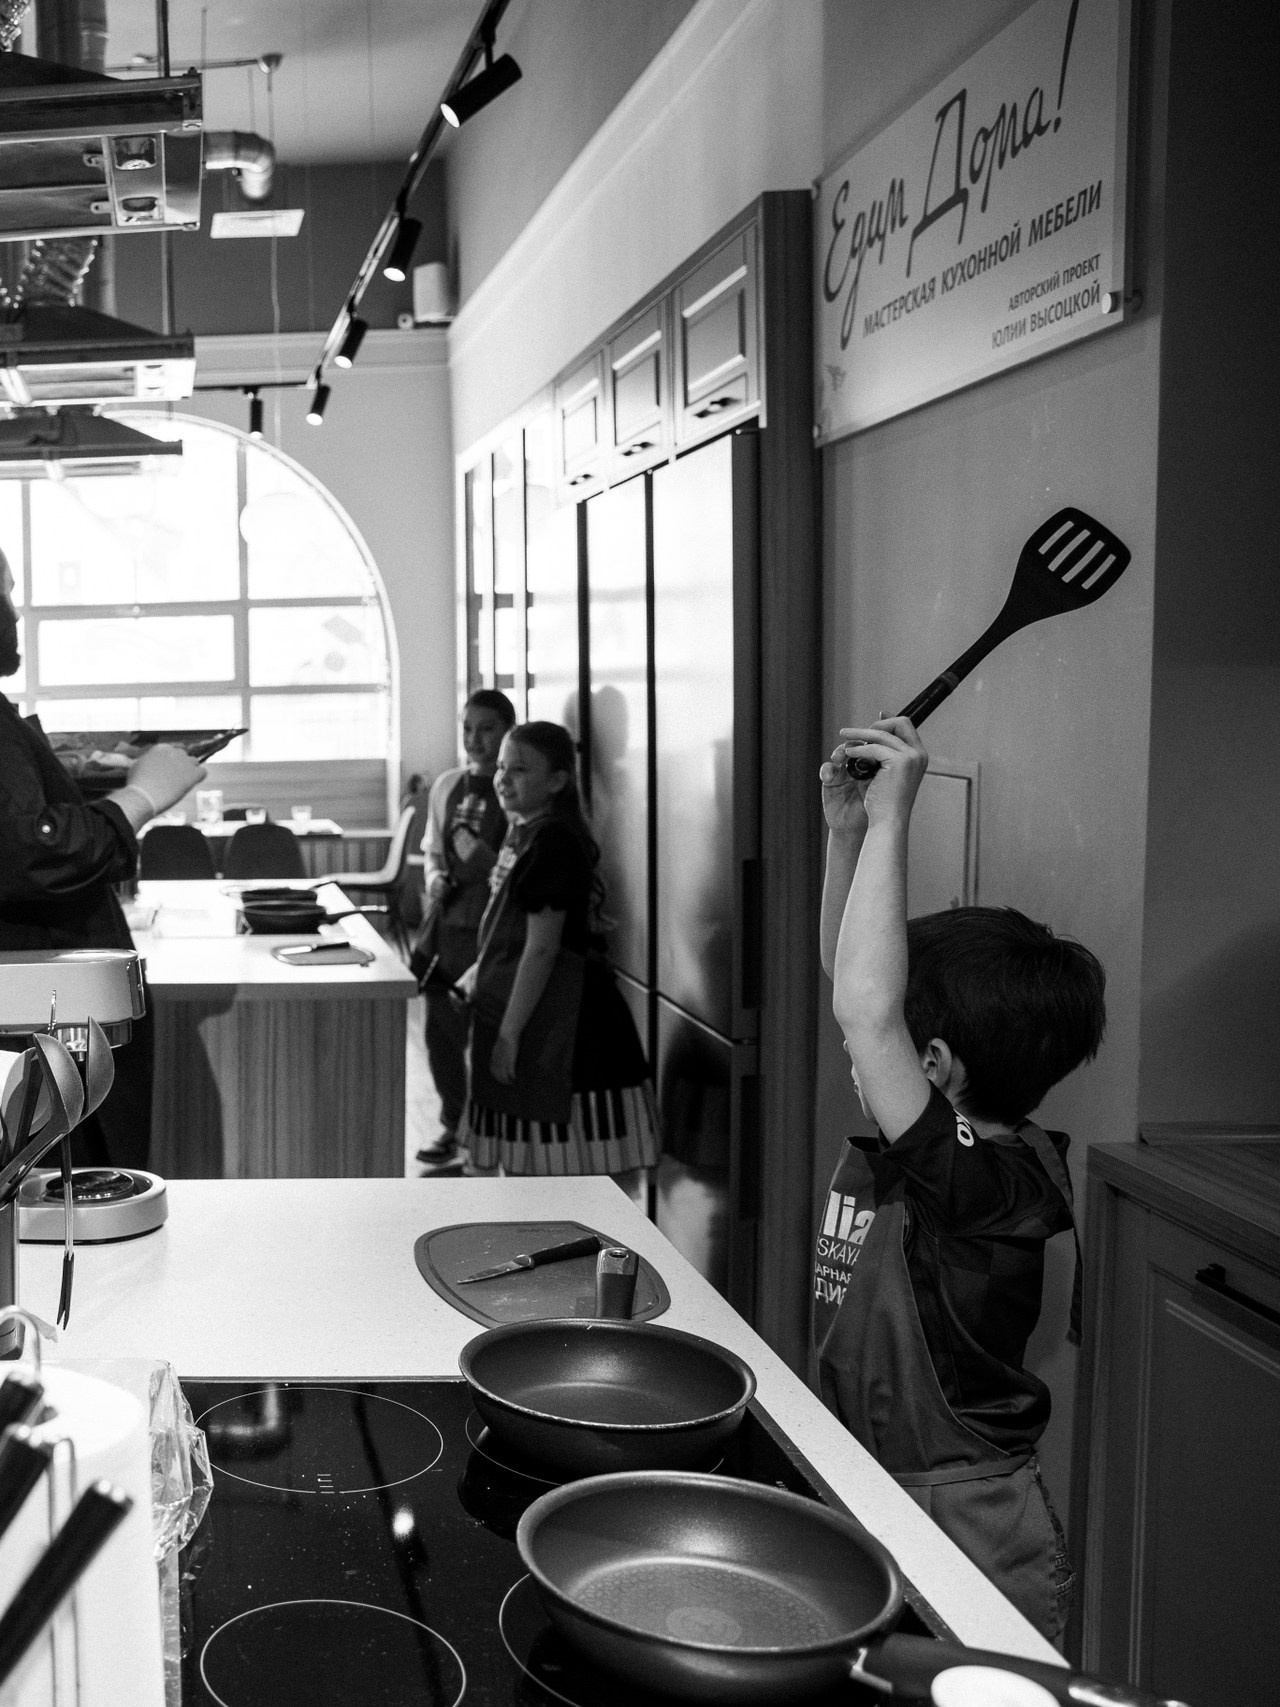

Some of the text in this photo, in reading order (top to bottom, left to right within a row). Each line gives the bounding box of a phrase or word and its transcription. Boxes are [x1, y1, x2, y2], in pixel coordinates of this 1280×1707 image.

[862, 179, 1103, 339] МАСТЕРСКАЯ КУХОННОЙ МЕБЕЛИ
[1007, 253, 1101, 313] АВТОРСКИЙ ПРОЕКТ
[991, 283, 1101, 351] ЮЛИИ ВЫСОЦКОЙ
[823, 1190, 876, 1245] lia
